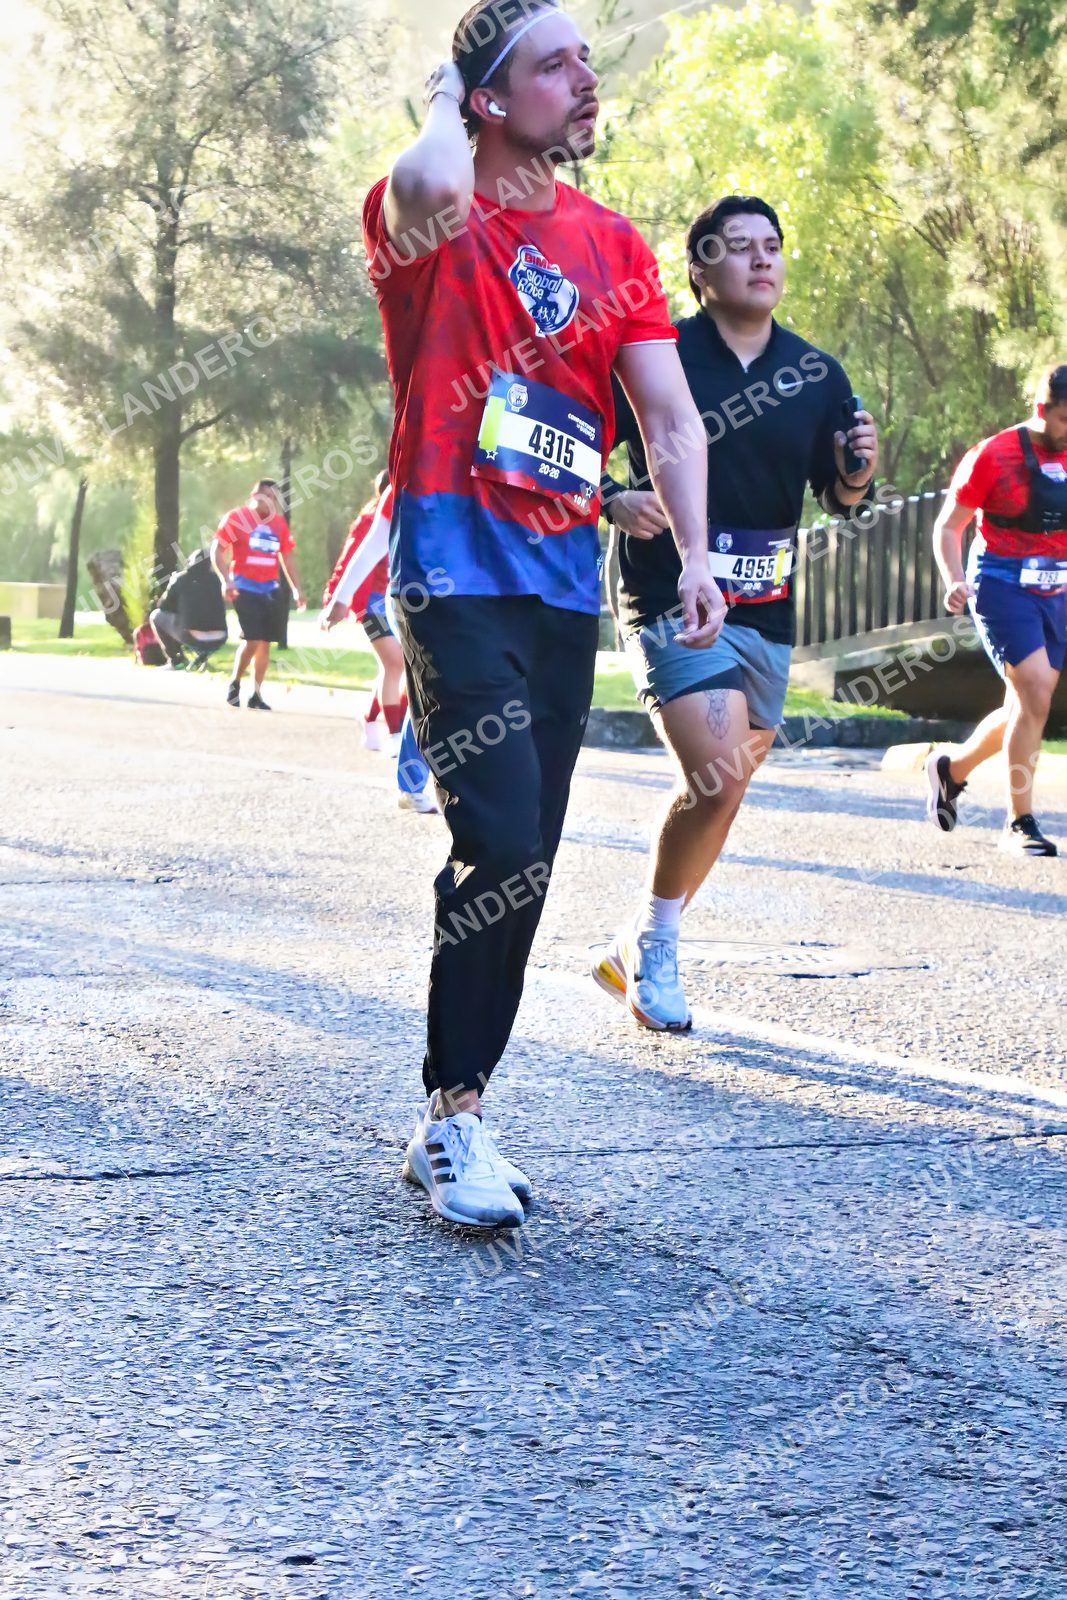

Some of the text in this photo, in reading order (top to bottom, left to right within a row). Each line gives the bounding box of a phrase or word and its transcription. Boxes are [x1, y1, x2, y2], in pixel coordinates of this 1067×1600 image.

[517, 277, 545, 300] Race
[526, 269, 562, 293] Global
[528, 424, 576, 468] 4315
[732, 557, 775, 579] 4955
